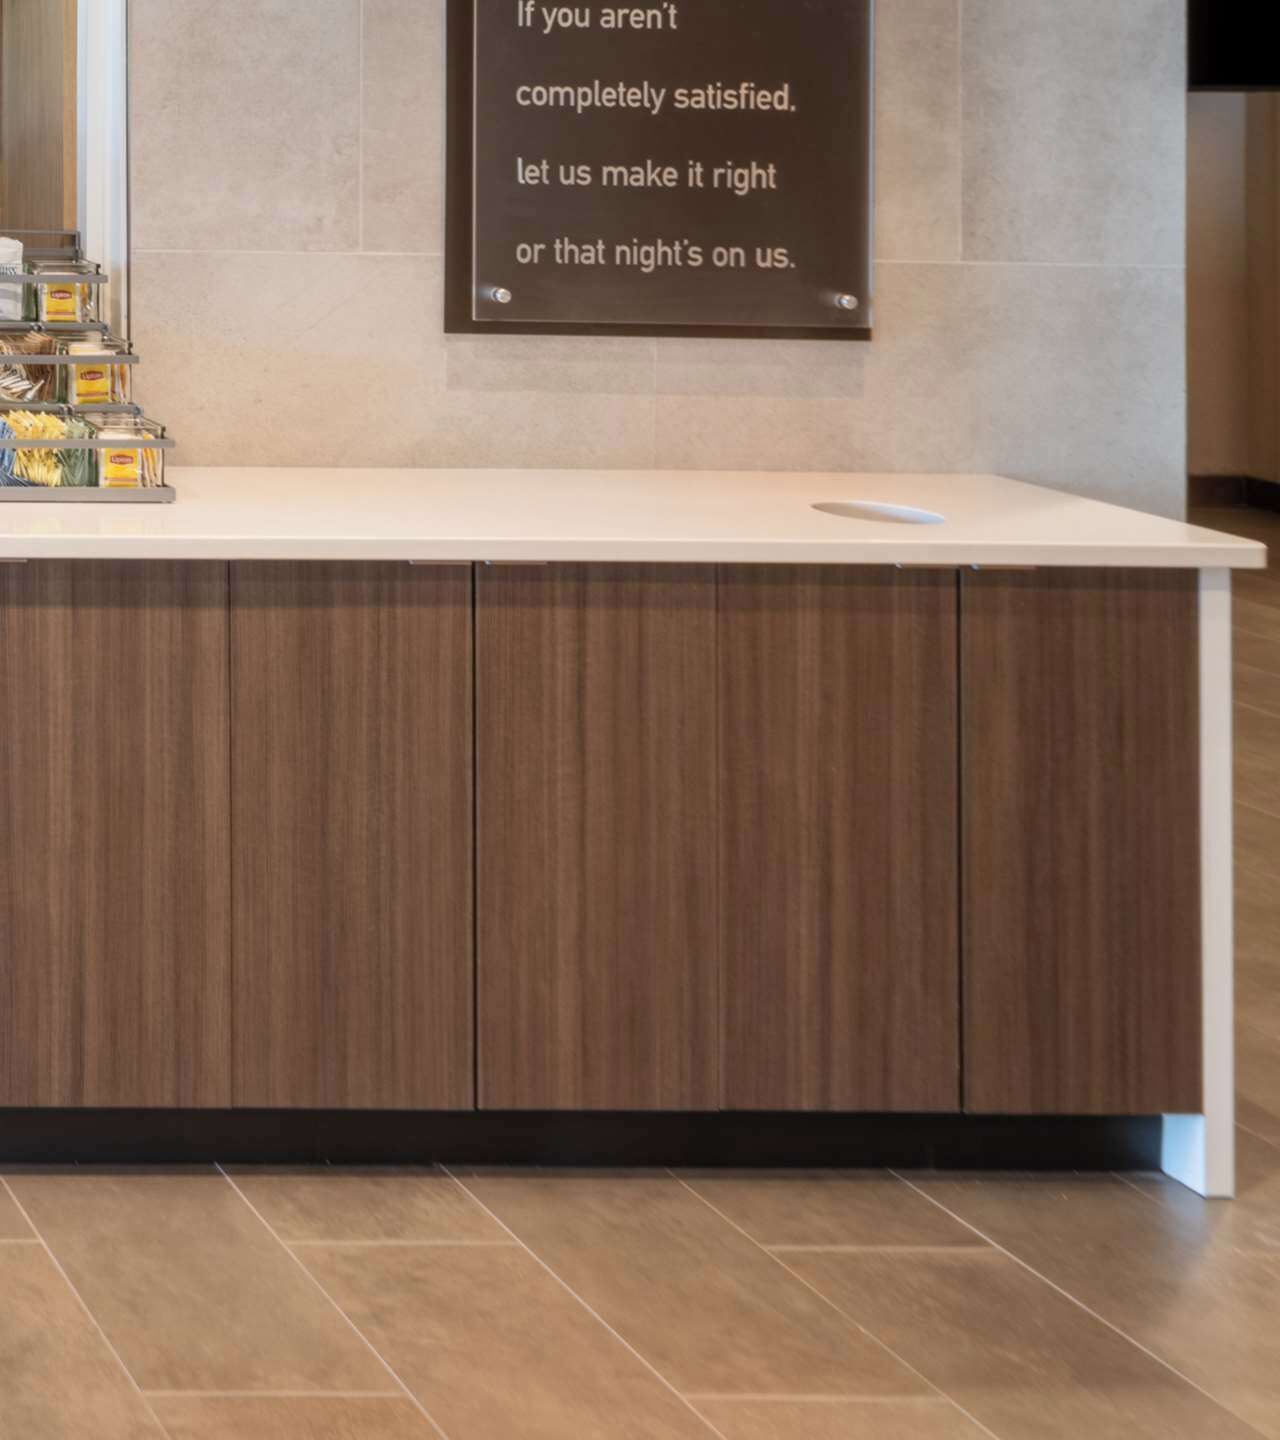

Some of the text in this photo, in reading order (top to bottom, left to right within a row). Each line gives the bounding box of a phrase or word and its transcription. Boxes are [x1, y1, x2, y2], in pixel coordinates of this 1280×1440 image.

[517, 0, 678, 34] If you aren't
[516, 80, 797, 115] completely satisfied.
[517, 157, 777, 195] let us make it right
[516, 237, 796, 272] or that night's on us.
